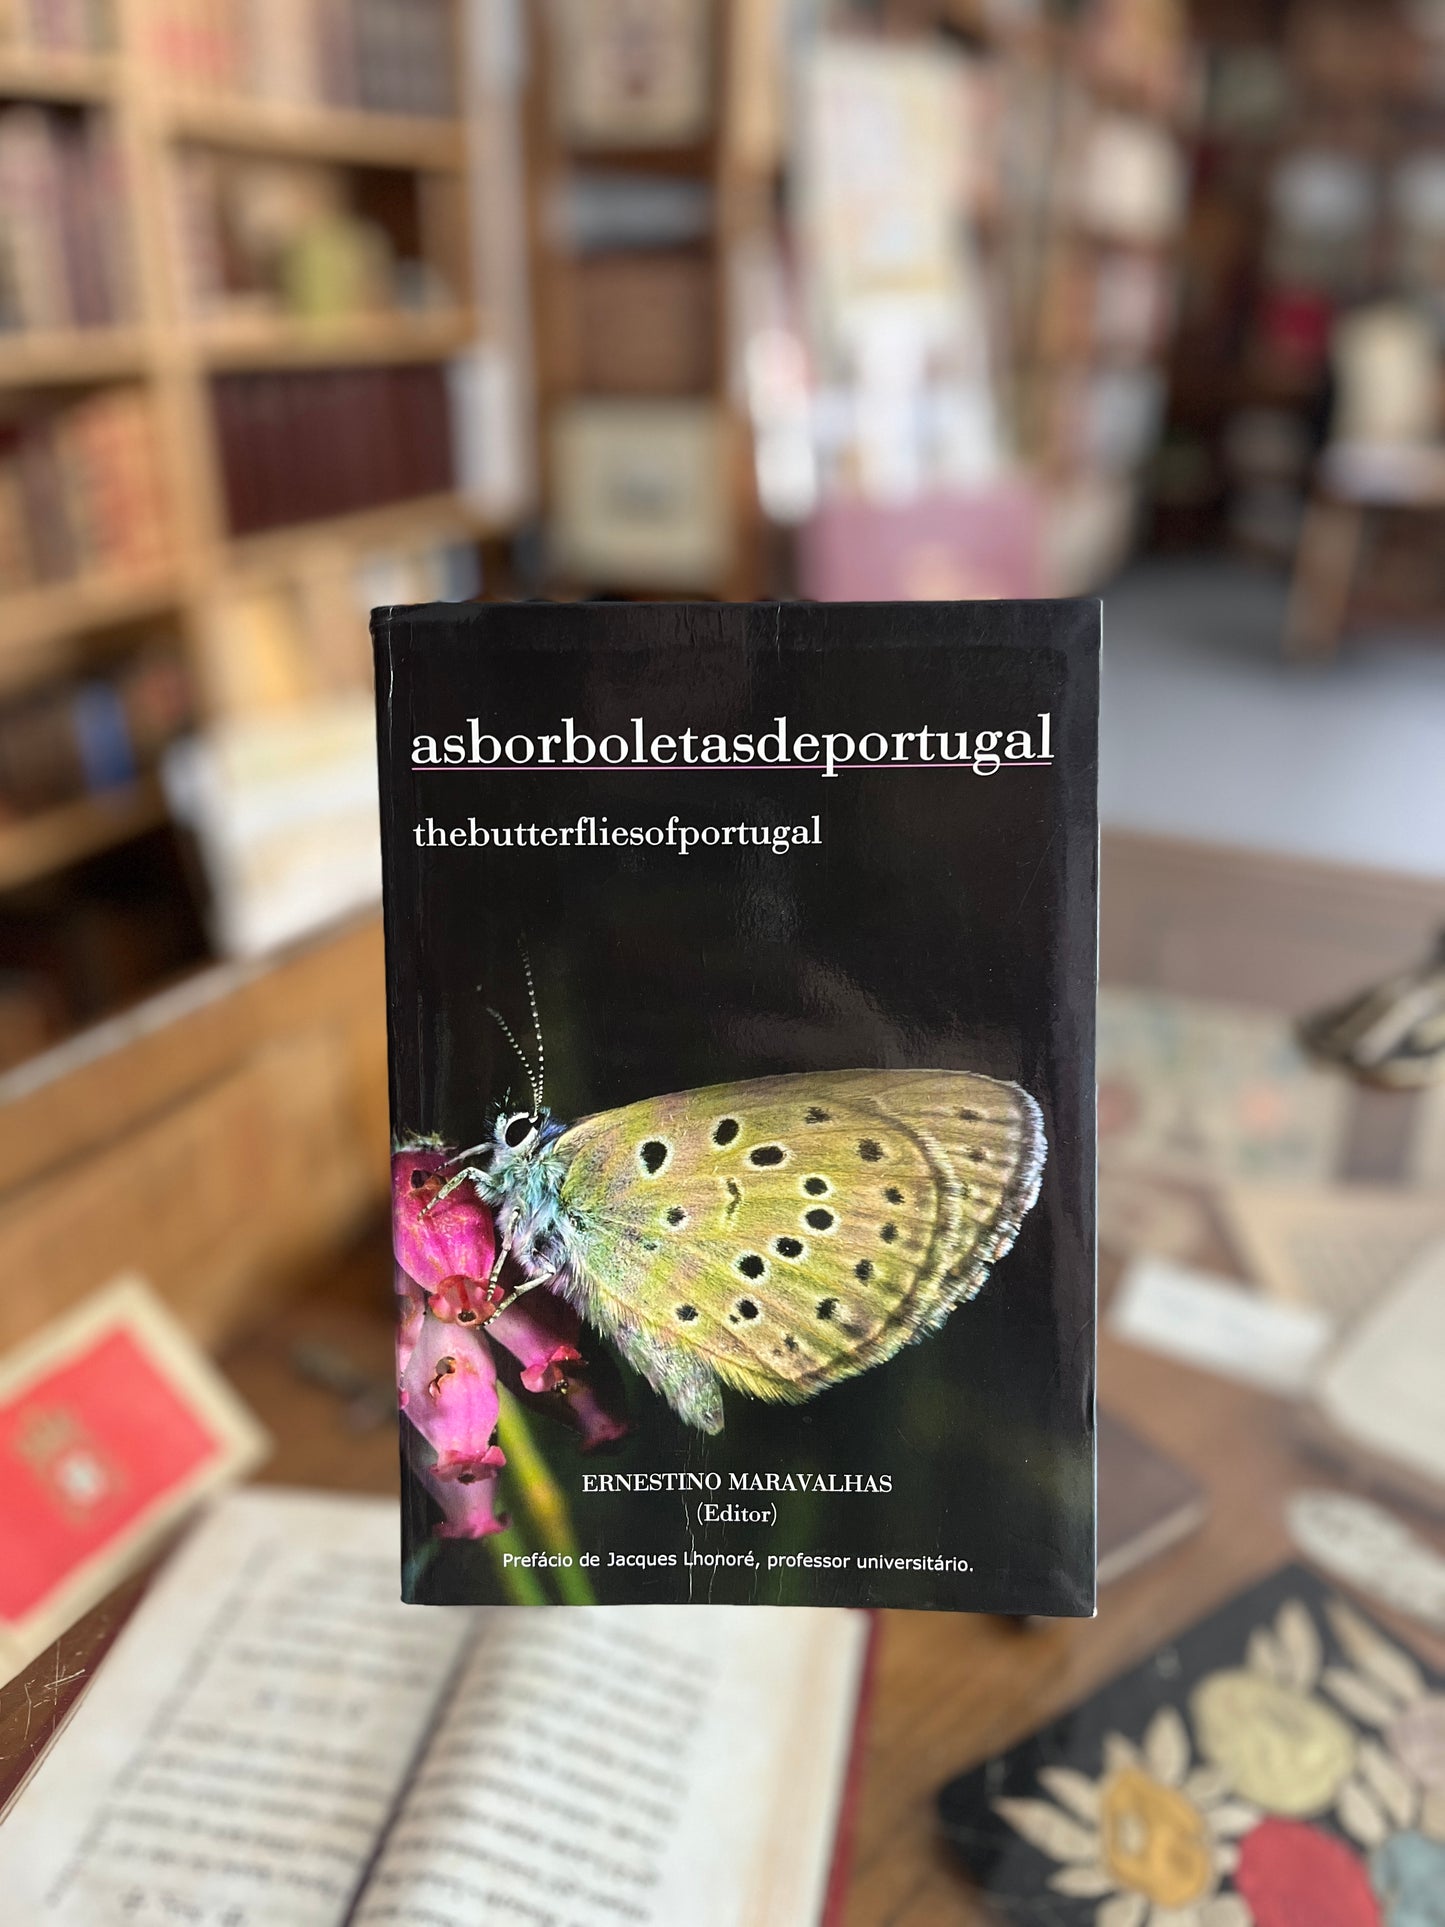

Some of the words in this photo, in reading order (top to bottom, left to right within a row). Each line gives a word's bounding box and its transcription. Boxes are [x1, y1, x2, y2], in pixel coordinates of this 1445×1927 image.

[411, 712, 1055, 777] asborboletasdeportugal
[413, 815, 822, 855] thebutterfliesofportugal
[582, 1473, 722, 1493] ERNESTINO
[728, 1473, 893, 1494] MARAVALHAS
[696, 1503, 778, 1526] (Editor)
[502, 1552, 573, 1568] Prefácio
[578, 1552, 601, 1567] de
[606, 1552, 678, 1571] Jacques
[684, 1550, 761, 1570] Lhonoré,
[767, 1552, 851, 1572] professor
[856, 1552, 975, 1572] universitário.
